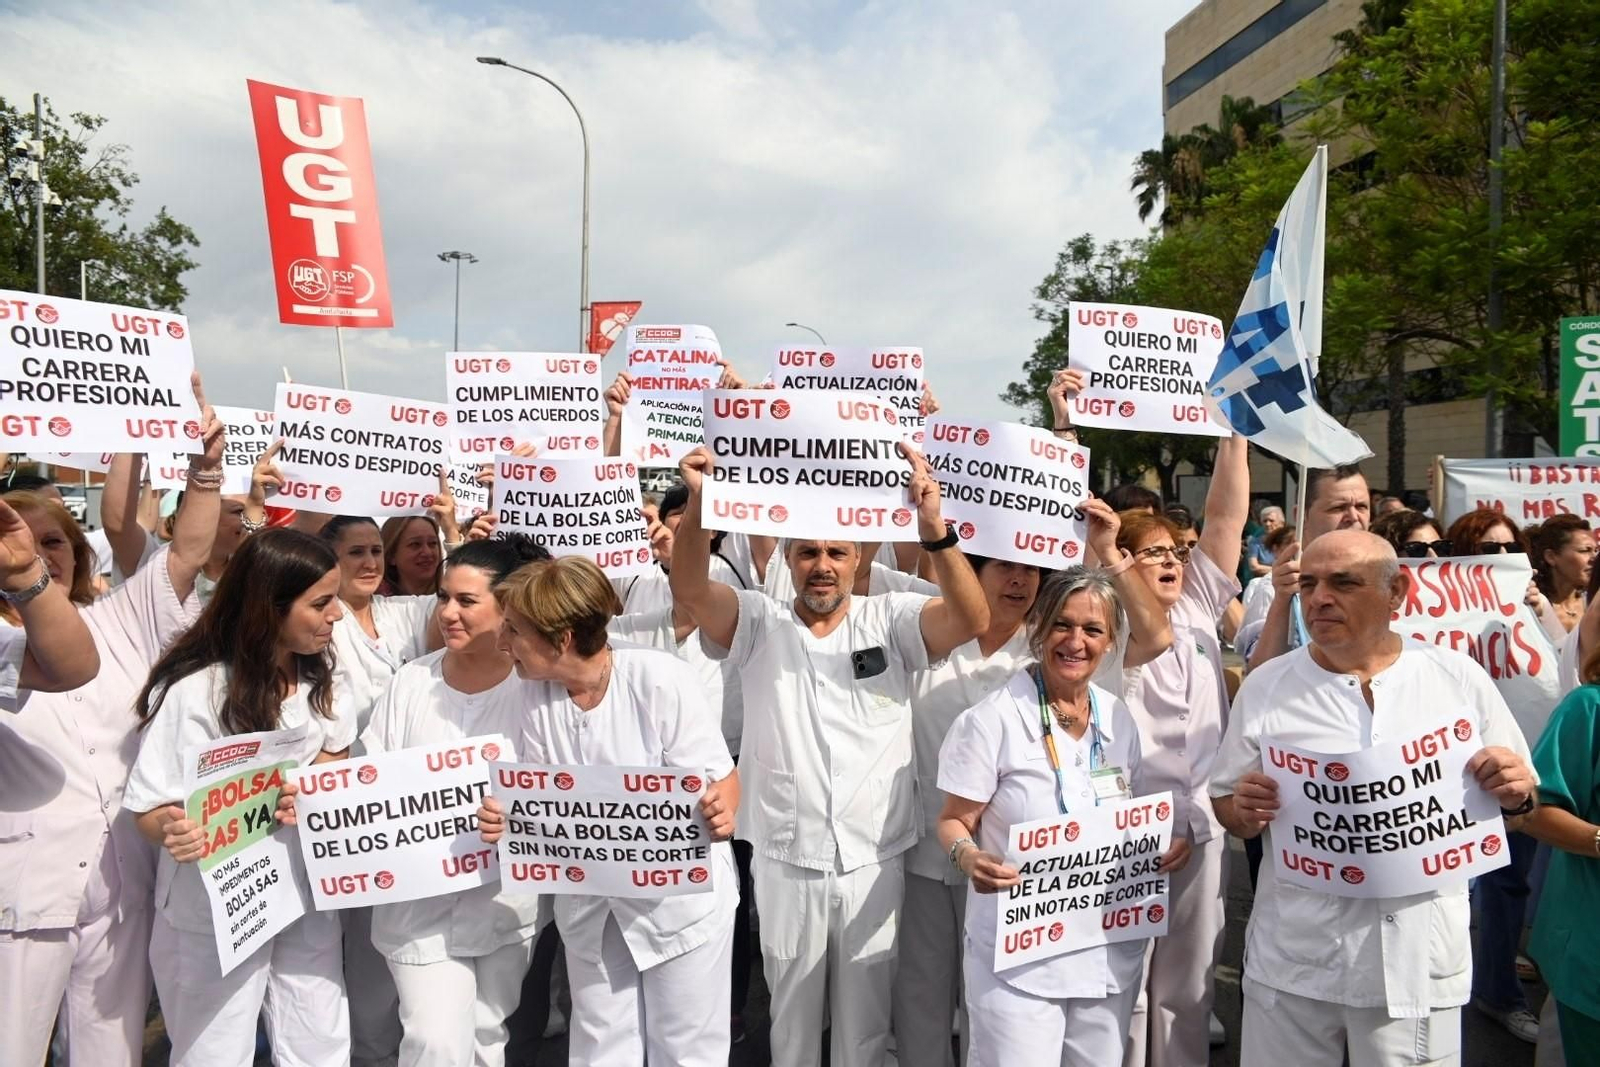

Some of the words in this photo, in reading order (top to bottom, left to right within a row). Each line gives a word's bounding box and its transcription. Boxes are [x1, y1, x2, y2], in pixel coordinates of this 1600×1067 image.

[275, 95, 357, 257] UGT
[333, 271, 354, 283] FSP
[111, 313, 161, 336] UGT
[1078, 310, 1118, 326] UGT
[1173, 317, 1207, 336] UGT
[10, 325, 113, 352] QUIERO
[121, 336, 150, 356] MI
[1104, 330, 1171, 351] QUIERO
[1177, 336, 1197, 354] MI
[455, 359, 492, 373] UGT
[546, 359, 580, 374] UGT
[629, 349, 717, 366] ¡CATALINA
[778, 350, 816, 367] UGT
[871, 353, 908, 369] UGT
[1108, 355, 1193, 377] CARRERA
[22, 357, 150, 384] CARRERA
[0, 380, 180, 407] PROFESIONAL
[456, 386, 599, 402] CUMPLIMIENTO
[630, 377, 710, 390] MENTIRAS
[782, 375, 917, 391] ACTUALIZACIÓN
[1090, 372, 1209, 396] PROFESIONA
[287, 392, 331, 412] UGT
[641, 400, 689, 411] APLICACIÓN
[713, 398, 765, 419] UGT
[838, 400, 880, 421] UGT
[1074, 398, 1115, 417] UGT
[2, 415, 41, 436] GT
[390, 405, 430, 424] UGT
[457, 410, 477, 423] DE
[483, 409, 513, 422] LOS
[519, 408, 599, 422] ACUERDOS
[647, 412, 704, 428] ATENCIÓ
[900, 416, 925, 427] RTE
[126, 418, 177, 438] UGT
[280, 420, 325, 441] MÁS
[330, 428, 443, 454] CONTRATOS
[648, 428, 705, 444] PRIMARIA
[933, 424, 972, 443] UGT
[459, 438, 496, 453] UGT
[548, 436, 581, 450] UGT
[713, 436, 906, 460] CUMPLIMIENTO
[1030, 439, 1068, 463] UGT
[279, 447, 350, 468] MENOS
[355, 454, 442, 477] DESPIDOS
[501, 462, 536, 481] UGT
[595, 463, 623, 481] UGT
[713, 466, 740, 483] DE
[747, 467, 788, 485] LOS
[795, 468, 910, 488] ACUERDOS
[926, 452, 962, 474] MÁS
[967, 460, 1082, 497] CONTRATOS
[278, 480, 322, 500] UGT
[380, 491, 419, 508] UGT
[504, 486, 634, 508] ACTUALIZACIÓN
[935, 481, 984, 503] ENOS
[989, 489, 1085, 521] DESPIDOS
[500, 510, 520, 525] DE
[525, 513, 548, 528] LA
[553, 510, 611, 528] BOLSA
[615, 507, 641, 524] SAS
[713, 500, 764, 521] UGT
[837, 507, 887, 527] UGT
[582, 532, 601, 546] DE
[606, 528, 648, 545] CORTE
[1015, 531, 1059, 554] UGT
[597, 550, 633, 568] UGT
[1390, 561, 1516, 621] RSONAL
[213, 746, 247, 761] CCOO
[1401, 726, 1449, 764] UGT
[426, 745, 476, 773] UGT
[1269, 746, 1318, 778] UGT
[300, 768, 352, 796] UGT
[499, 769, 549, 790] UGT
[623, 773, 675, 793] UGT
[1303, 775, 1405, 805] QUIERO
[1412, 759, 1442, 789] MI
[202, 768, 283, 825] ¡BOLSA
[307, 780, 489, 832] CUMPLIMIENT
[244, 803, 271, 834] YA
[510, 798, 692, 820] ACTUALIZACIÓN
[1115, 805, 1152, 830] UGT
[1313, 795, 1444, 833] CARRERA
[312, 839, 340, 859] DE
[345, 831, 389, 853] LOS
[395, 816, 479, 848] ACUERD
[509, 820, 537, 838] DE
[541, 823, 569, 840] LA
[575, 822, 647, 842] BOLSA
[654, 824, 700, 841] SAS
[1019, 825, 1061, 852] UGT
[1294, 808, 1477, 855] PROFESIONAL
[509, 840, 539, 856] SIN
[544, 843, 608, 861] NOTAS
[613, 848, 637, 862] DE
[642, 846, 707, 862] CORTE
[1019, 833, 1161, 875] ACTUALIZACIÓN
[1422, 842, 1476, 877] UGT
[212, 869, 223, 882] NO
[223, 857, 240, 875] MAS
[442, 849, 492, 878] UGT
[511, 863, 561, 882] UGT
[1283, 849, 1334, 881] UGT
[219, 855, 271, 895] IMPEDIMENTOS
[321, 873, 369, 897] UGT
[631, 869, 683, 887] UGT
[1009, 879, 1032, 900] DE
[1038, 876, 1061, 894] LA
[1066, 866, 1126, 890] BOLSA
[1130, 855, 1162, 878] SAS
[226, 884, 256, 918] BOLSA
[256, 869, 279, 893] SAS
[1005, 905, 1030, 925] SIN
[1034, 895, 1089, 919] NOTAS
[1093, 892, 1112, 908] DE
[1116, 879, 1165, 902] CORTE
[231, 921, 240, 935] sin
[240, 908, 258, 927] cortes
[259, 900, 267, 911] de
[1102, 906, 1144, 930] UGT
[232, 918, 267, 953] puntuación
[1005, 926, 1045, 954] UGT
